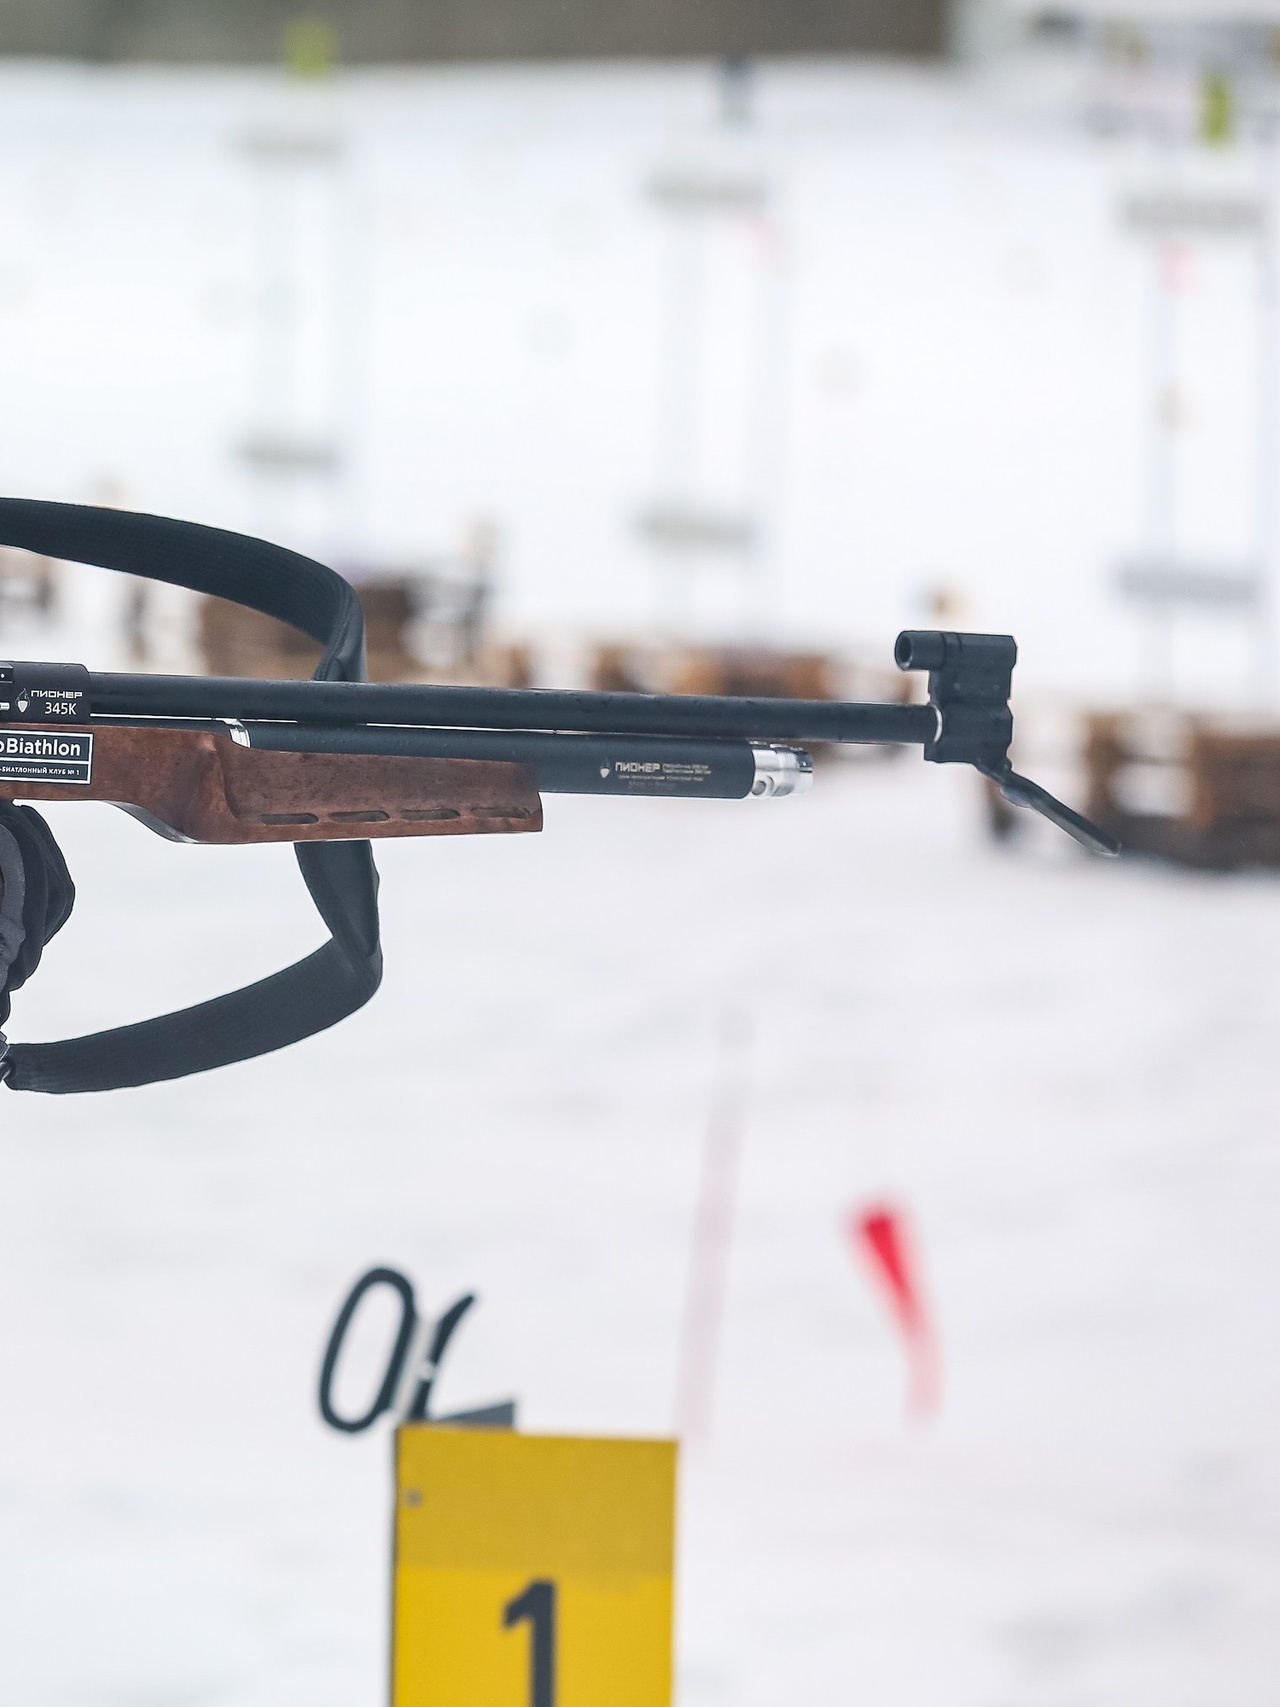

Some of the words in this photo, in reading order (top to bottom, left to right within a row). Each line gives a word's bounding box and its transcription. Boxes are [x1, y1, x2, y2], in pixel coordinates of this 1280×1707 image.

[30, 689, 83, 699] ПИОНЕР
[615, 761, 660, 773] ПИОНЕР
[502, 1576, 559, 1707] 1
